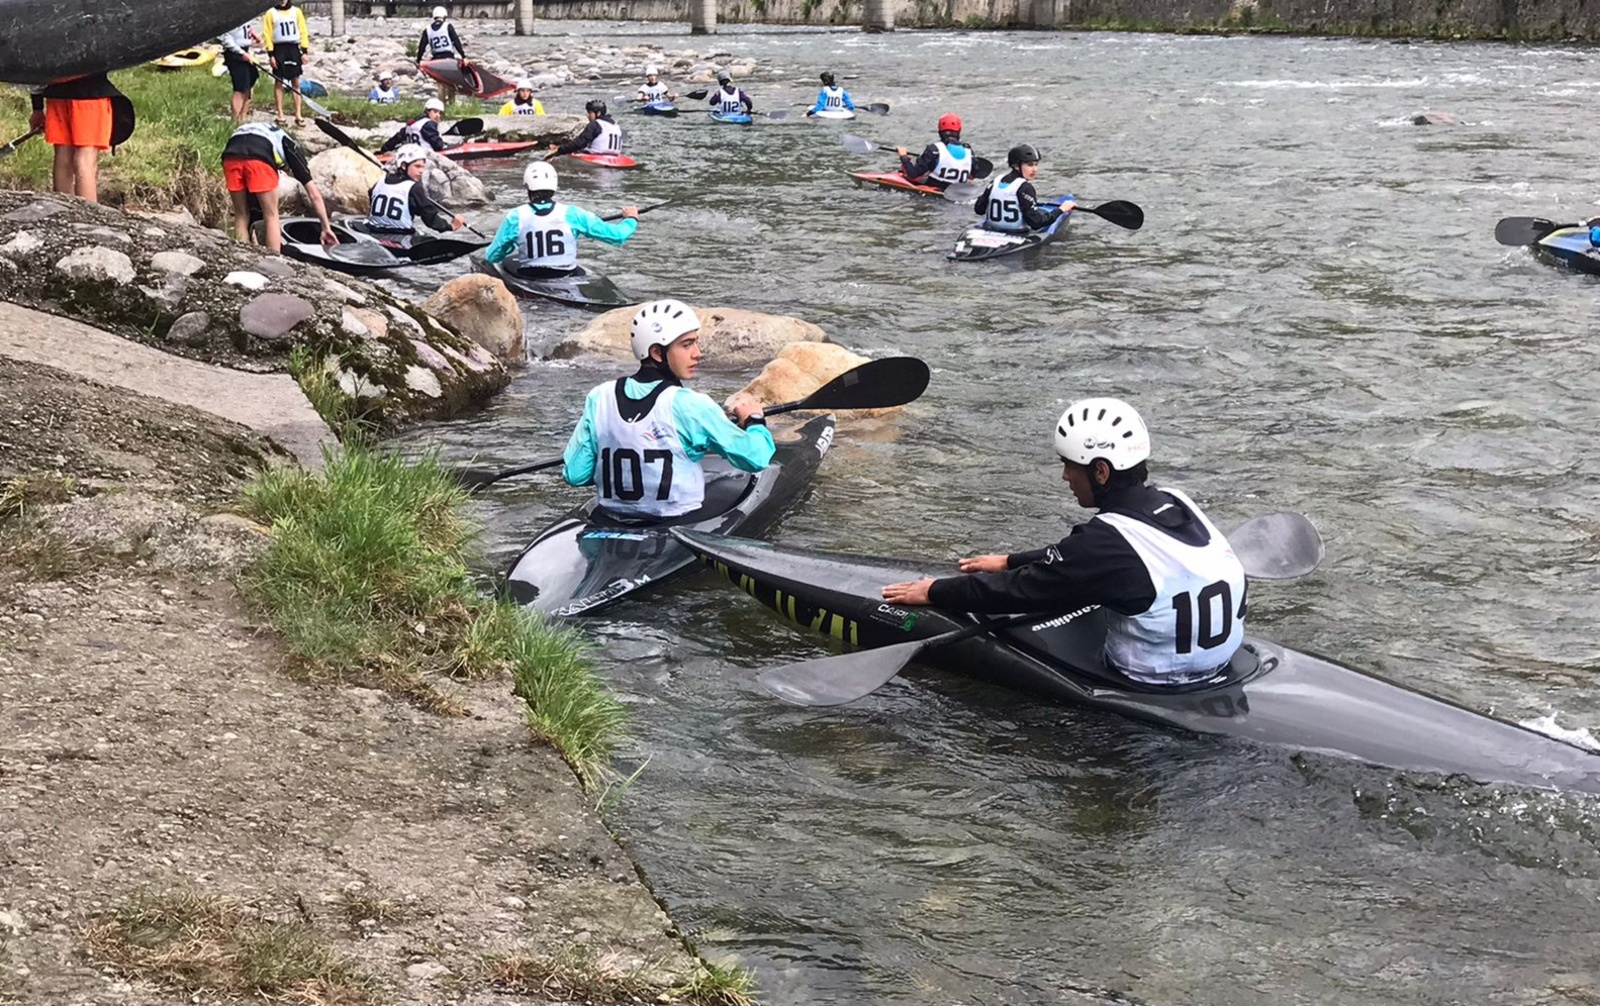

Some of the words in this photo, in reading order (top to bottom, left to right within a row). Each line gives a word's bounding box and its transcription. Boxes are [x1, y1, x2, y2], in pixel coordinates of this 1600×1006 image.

[280, 21, 297, 37] 117
[723, 101, 739, 113] 112
[826, 96, 840, 107] 110
[939, 162, 970, 183] 120
[525, 229, 565, 258] 116
[601, 447, 673, 501] 107
